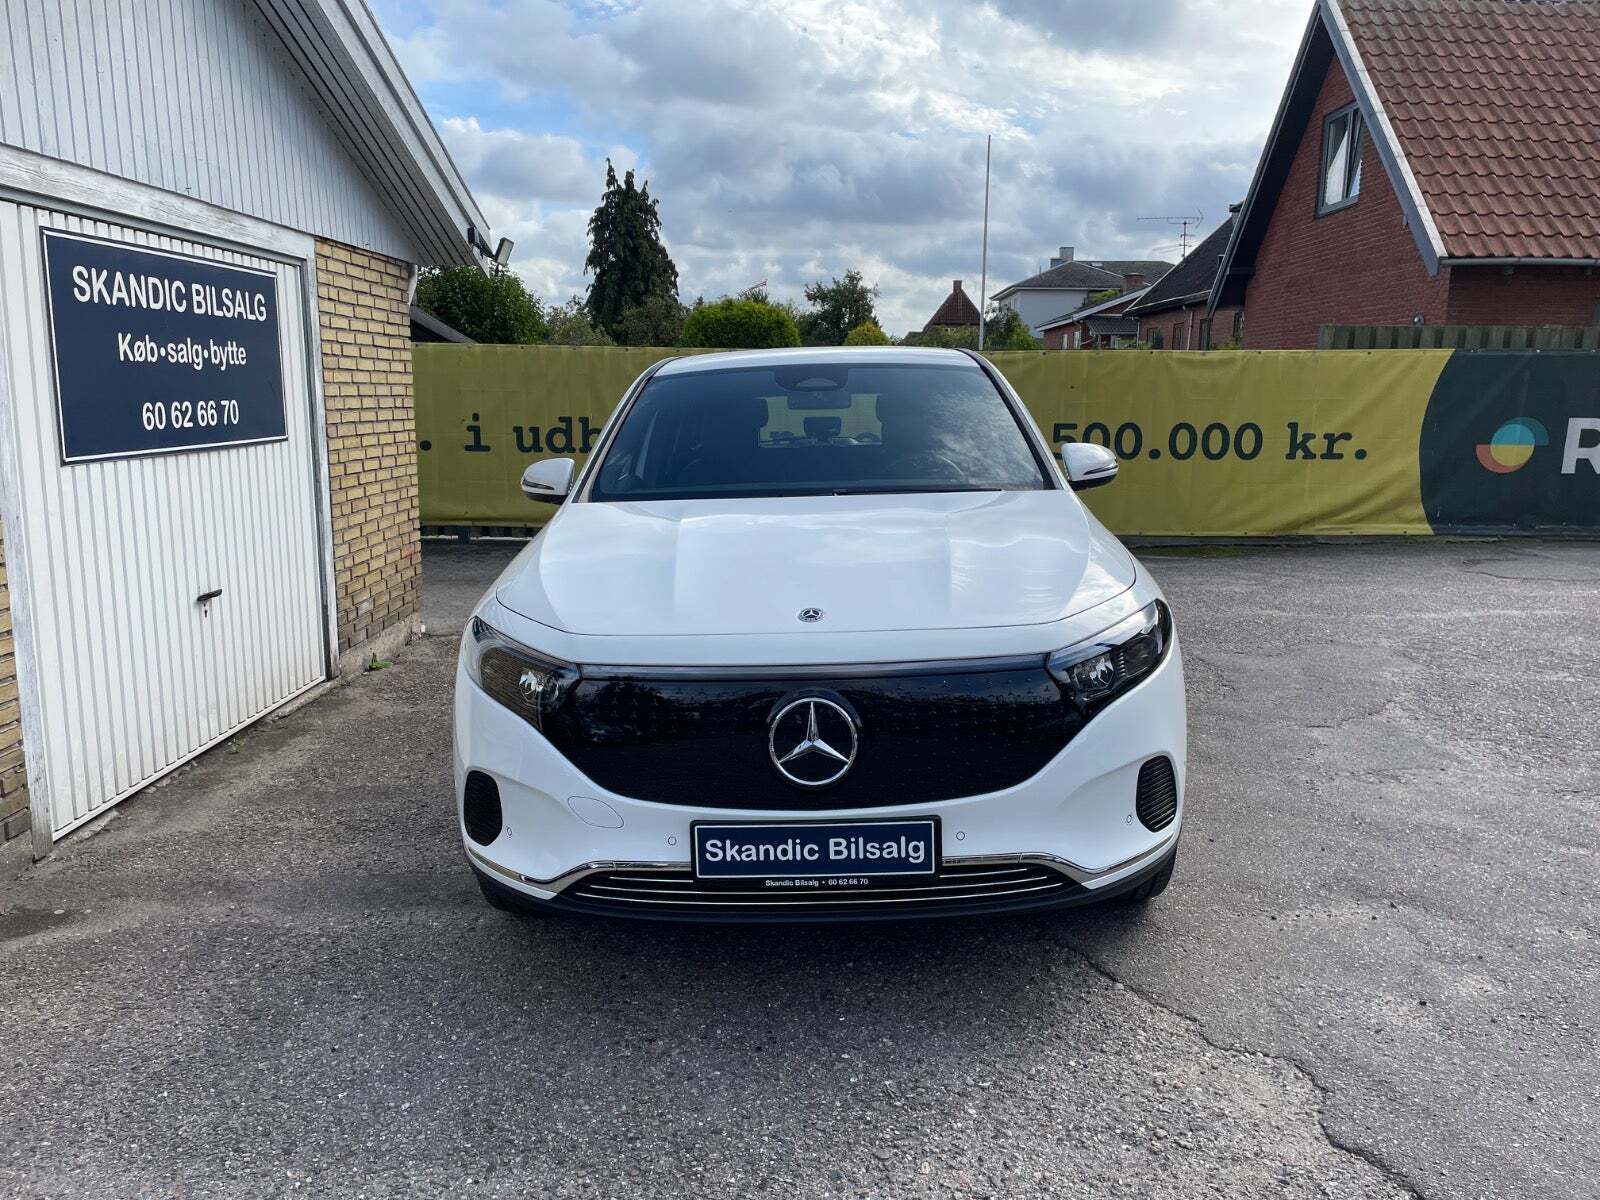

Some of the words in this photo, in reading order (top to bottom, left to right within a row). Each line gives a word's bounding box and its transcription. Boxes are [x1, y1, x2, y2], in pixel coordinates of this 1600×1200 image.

[72, 265, 187, 313] SKANDIC
[191, 283, 267, 322] BILSALG
[142, 402, 166, 431] 60
[171, 401, 193, 429] 62
[197, 400, 218, 427] 66
[221, 399, 239, 425] 70
[464, 412, 491, 452] i
[1285, 422, 1368, 460] kr.
[705, 838, 819, 862] Skandic
[828, 836, 925, 864] Bilsalg
[795, 879, 819, 888] Bilsalg
